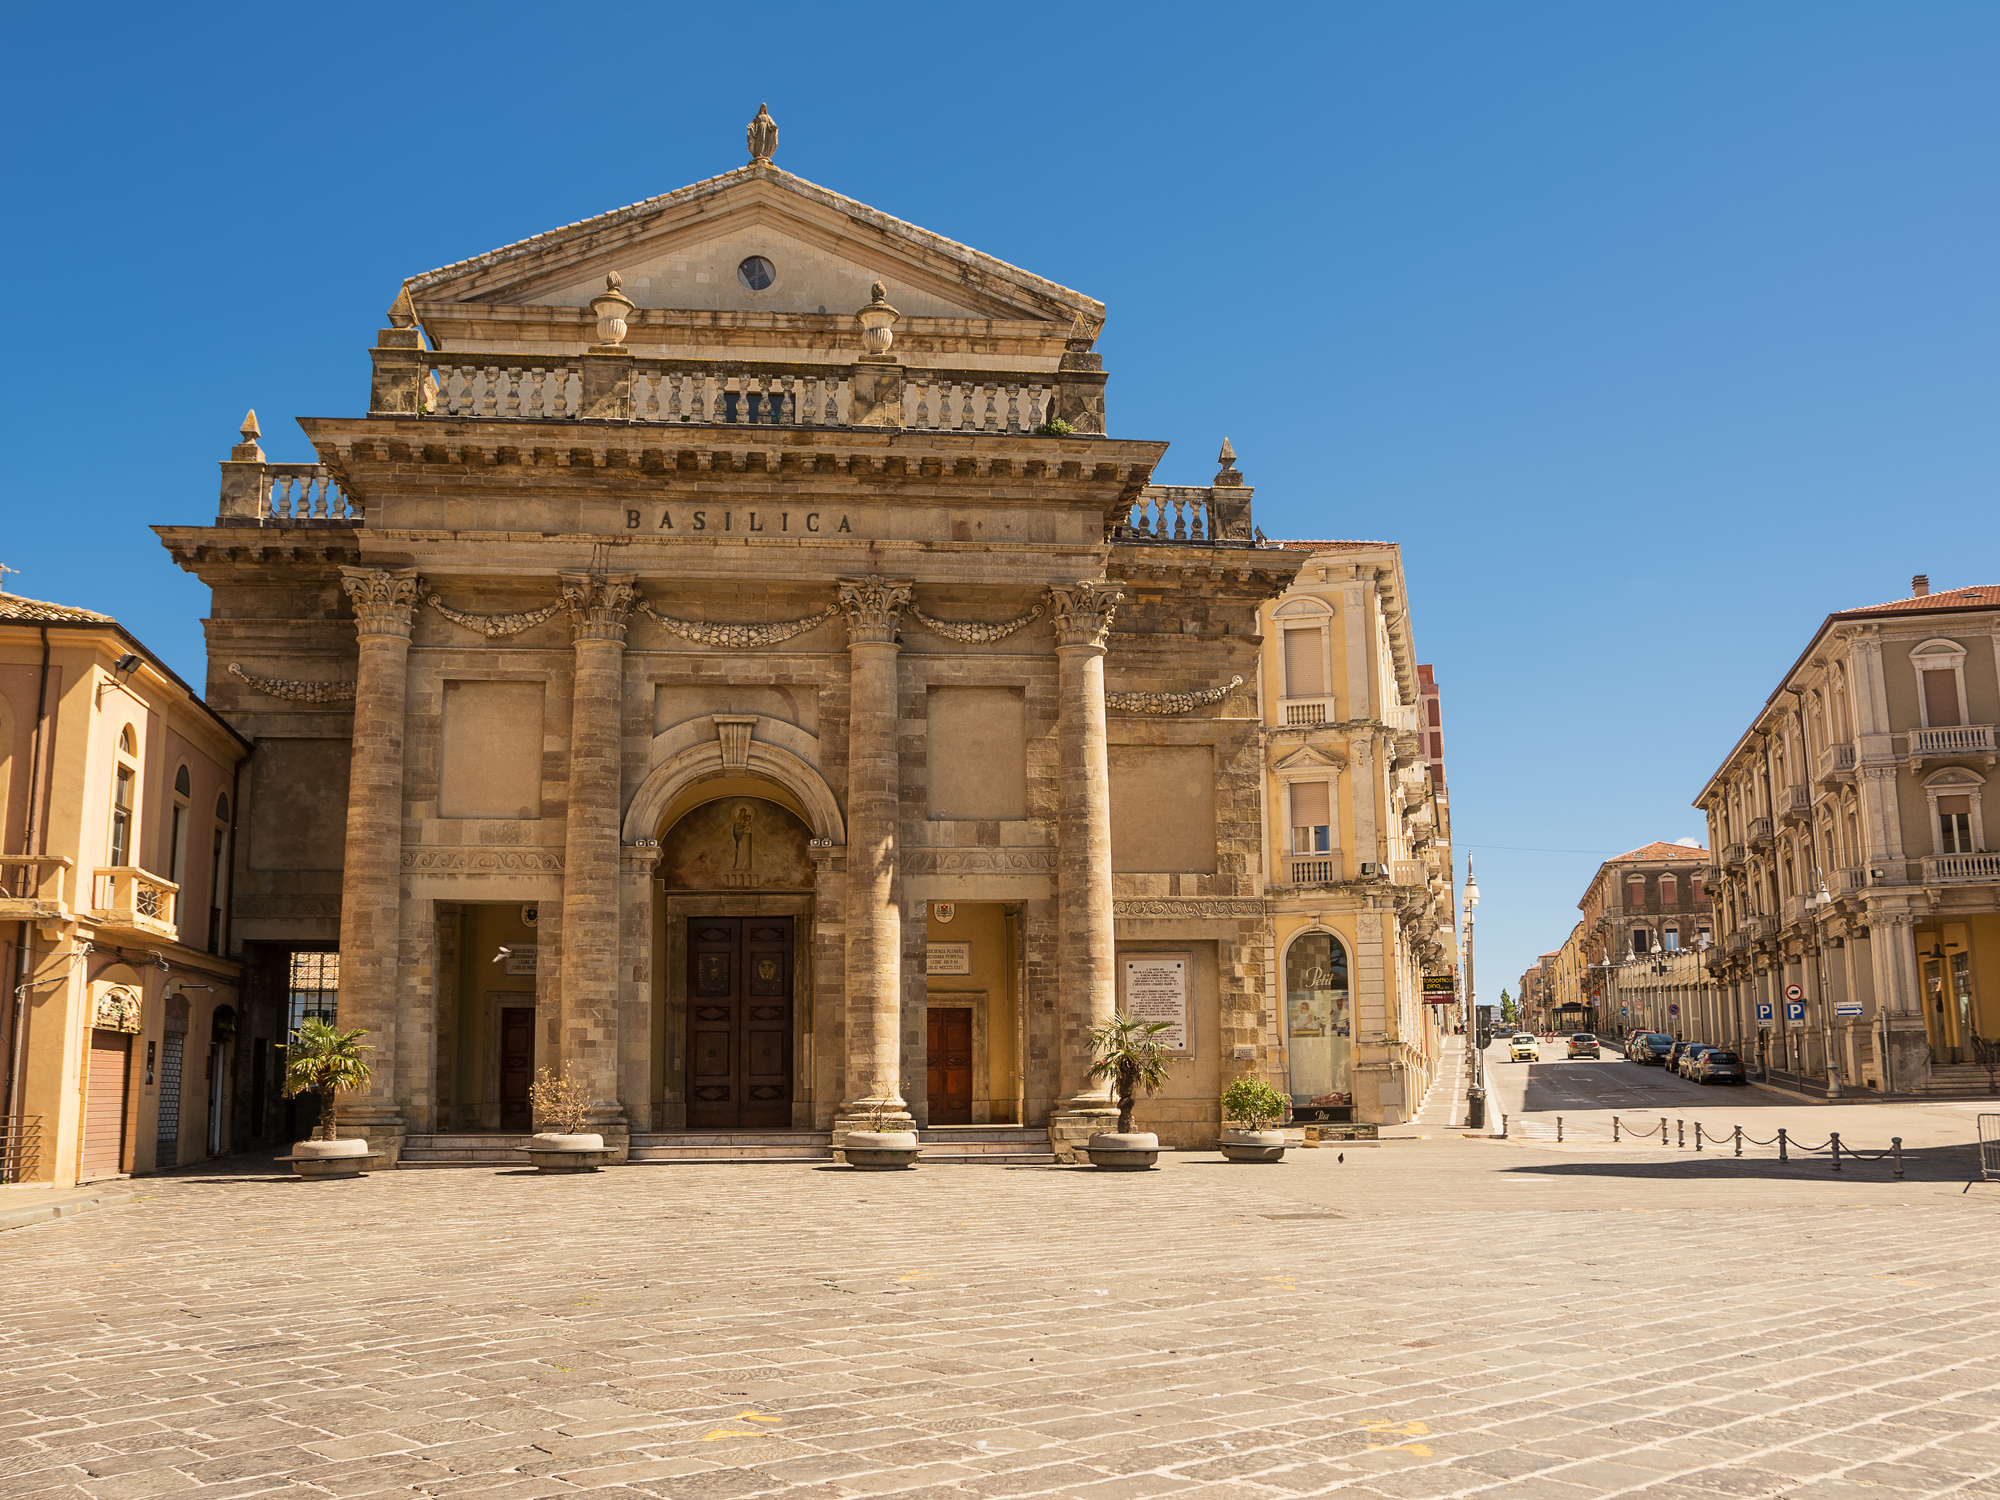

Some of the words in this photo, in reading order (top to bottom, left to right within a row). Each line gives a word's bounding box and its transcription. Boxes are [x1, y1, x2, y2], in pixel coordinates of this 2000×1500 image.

[626, 509, 852, 533] BASILICA
[1305, 966, 1334, 988] Petit
[1759, 1005, 1770, 1018] P
[1790, 1004, 1802, 1018] P
